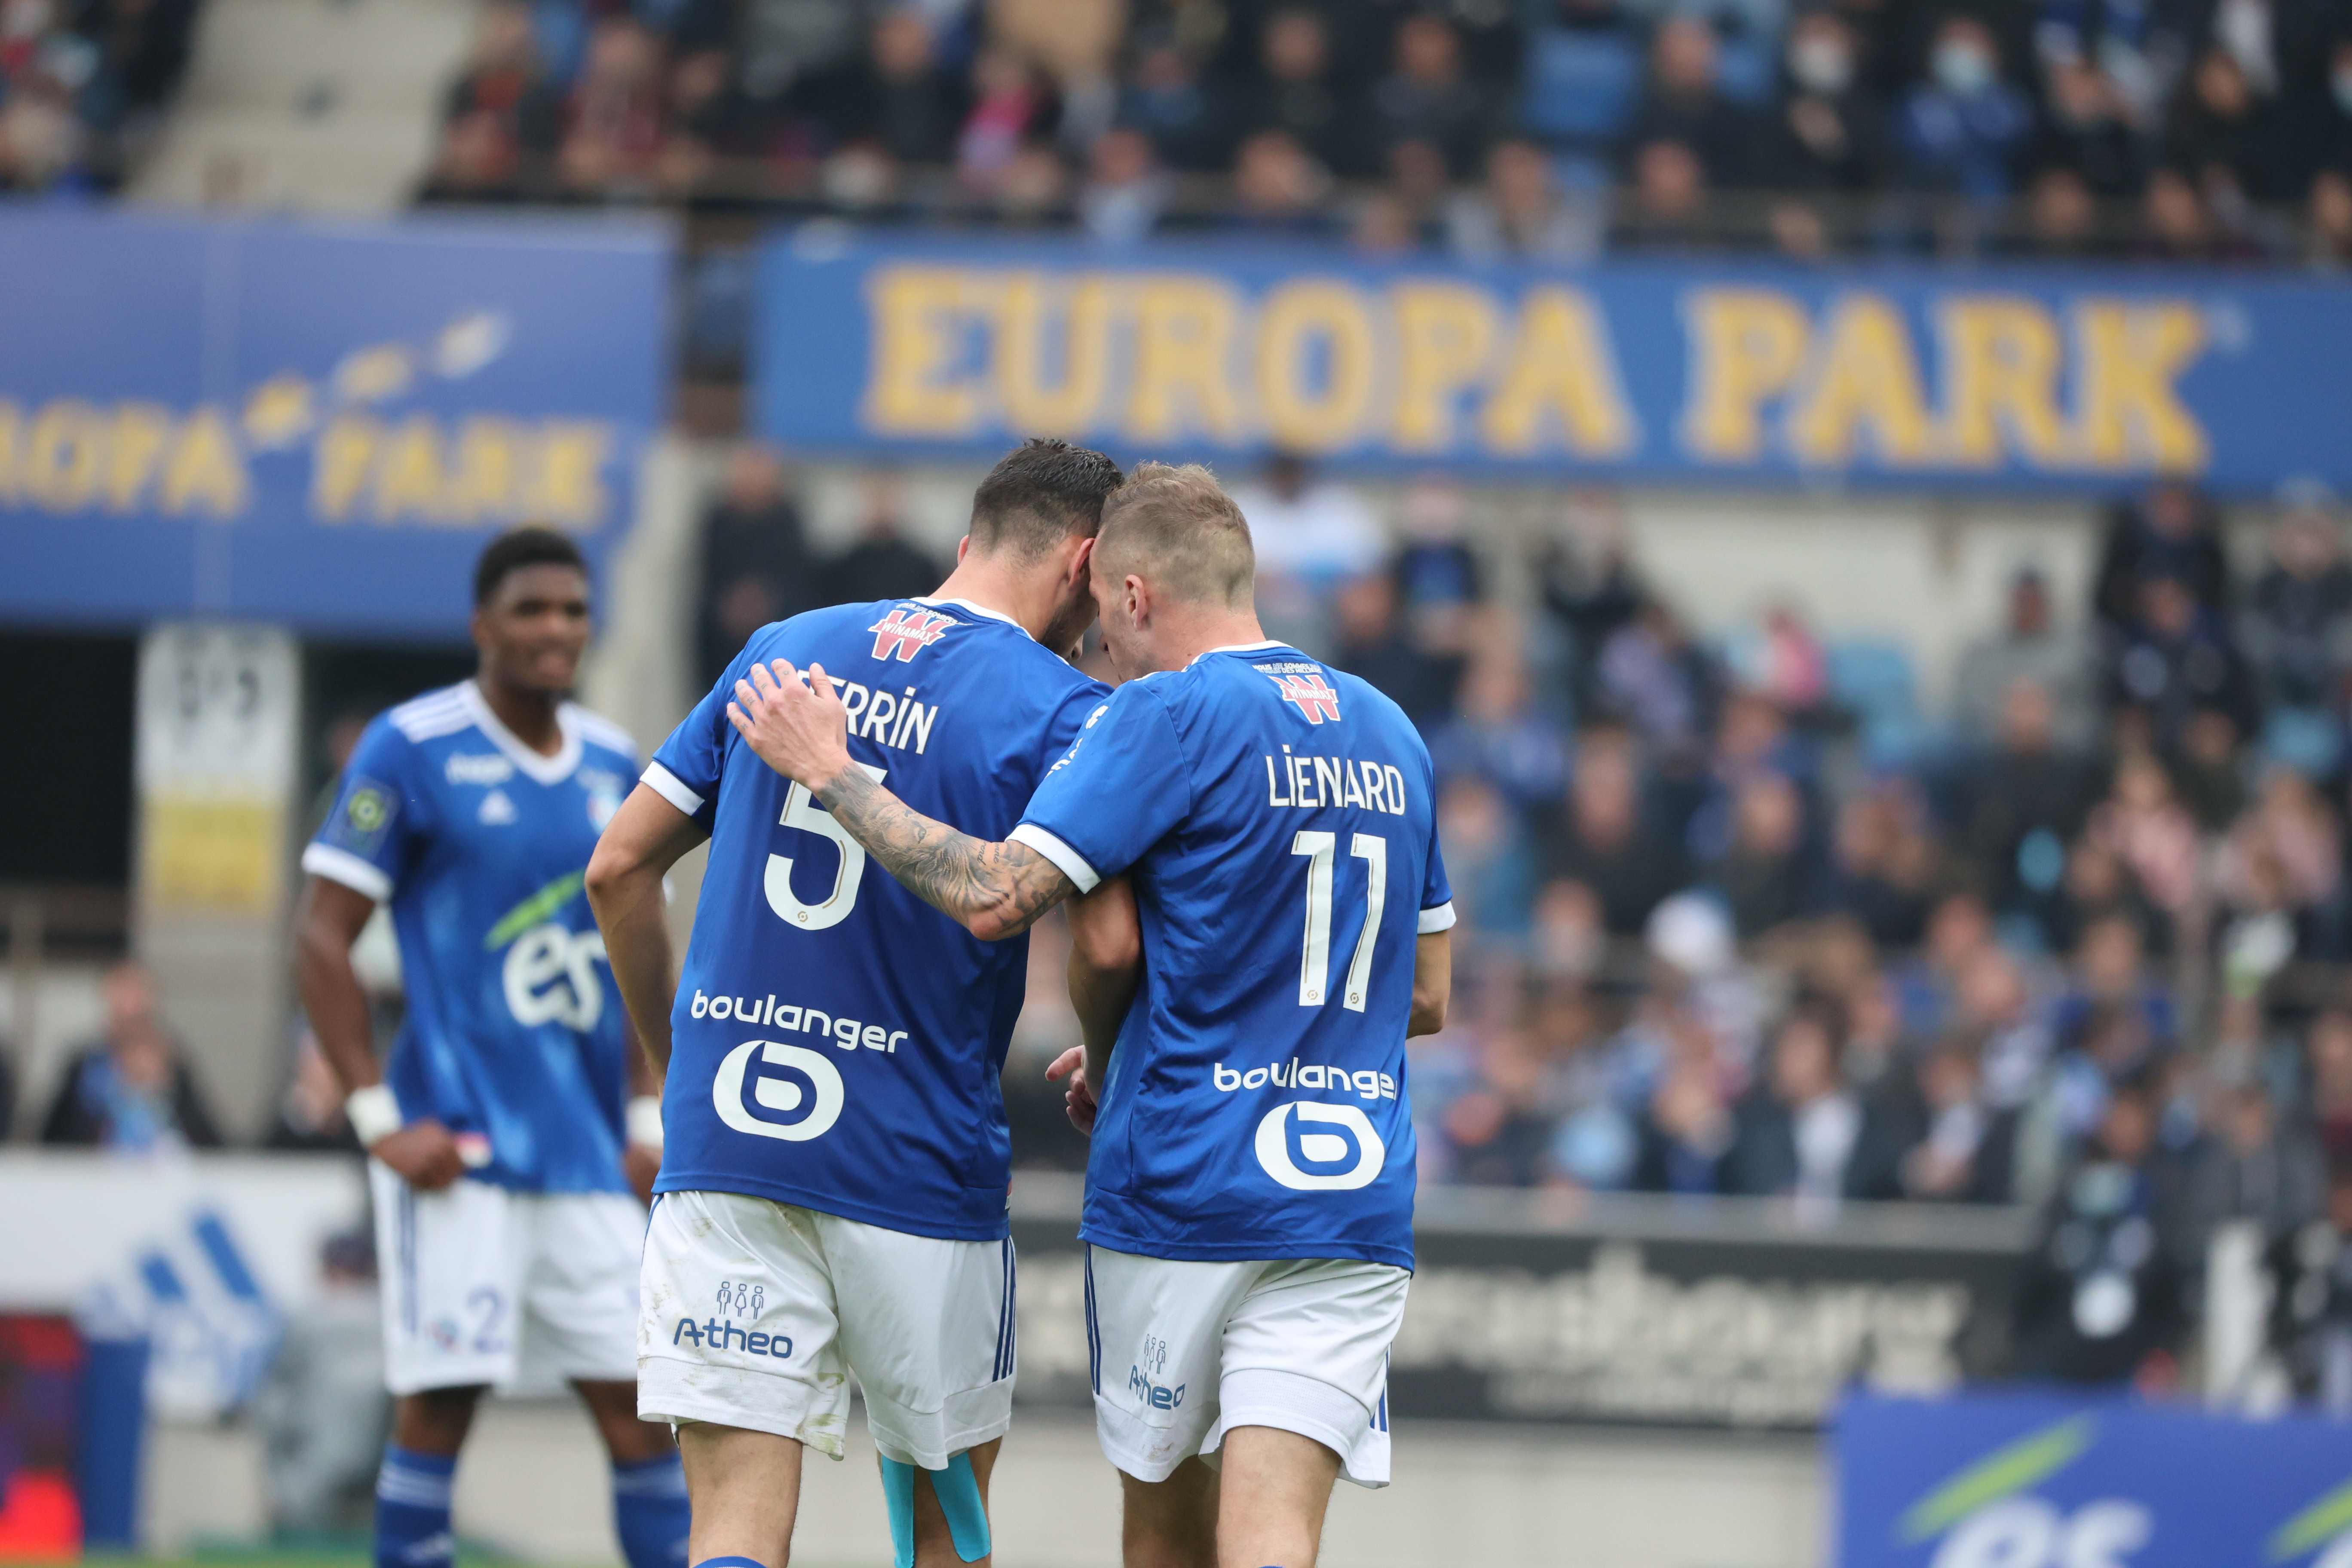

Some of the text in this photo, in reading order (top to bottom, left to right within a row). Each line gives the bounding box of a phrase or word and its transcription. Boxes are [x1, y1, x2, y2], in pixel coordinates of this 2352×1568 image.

[865, 263, 2211, 472] EUROPA PARK
[881, 622, 934, 642] WINAMAX
[1286, 688, 1334, 700] WINAMAX
[764, 760, 888, 931] 5
[1291, 830, 1387, 1013] 11
[691, 989, 908, 1054] boulanger
[1213, 1057, 1397, 1101] boulange
[466, 1286, 509, 1354] 2
[674, 1317, 793, 1358] Atheo
[1128, 1363, 1185, 1410] Atheo
